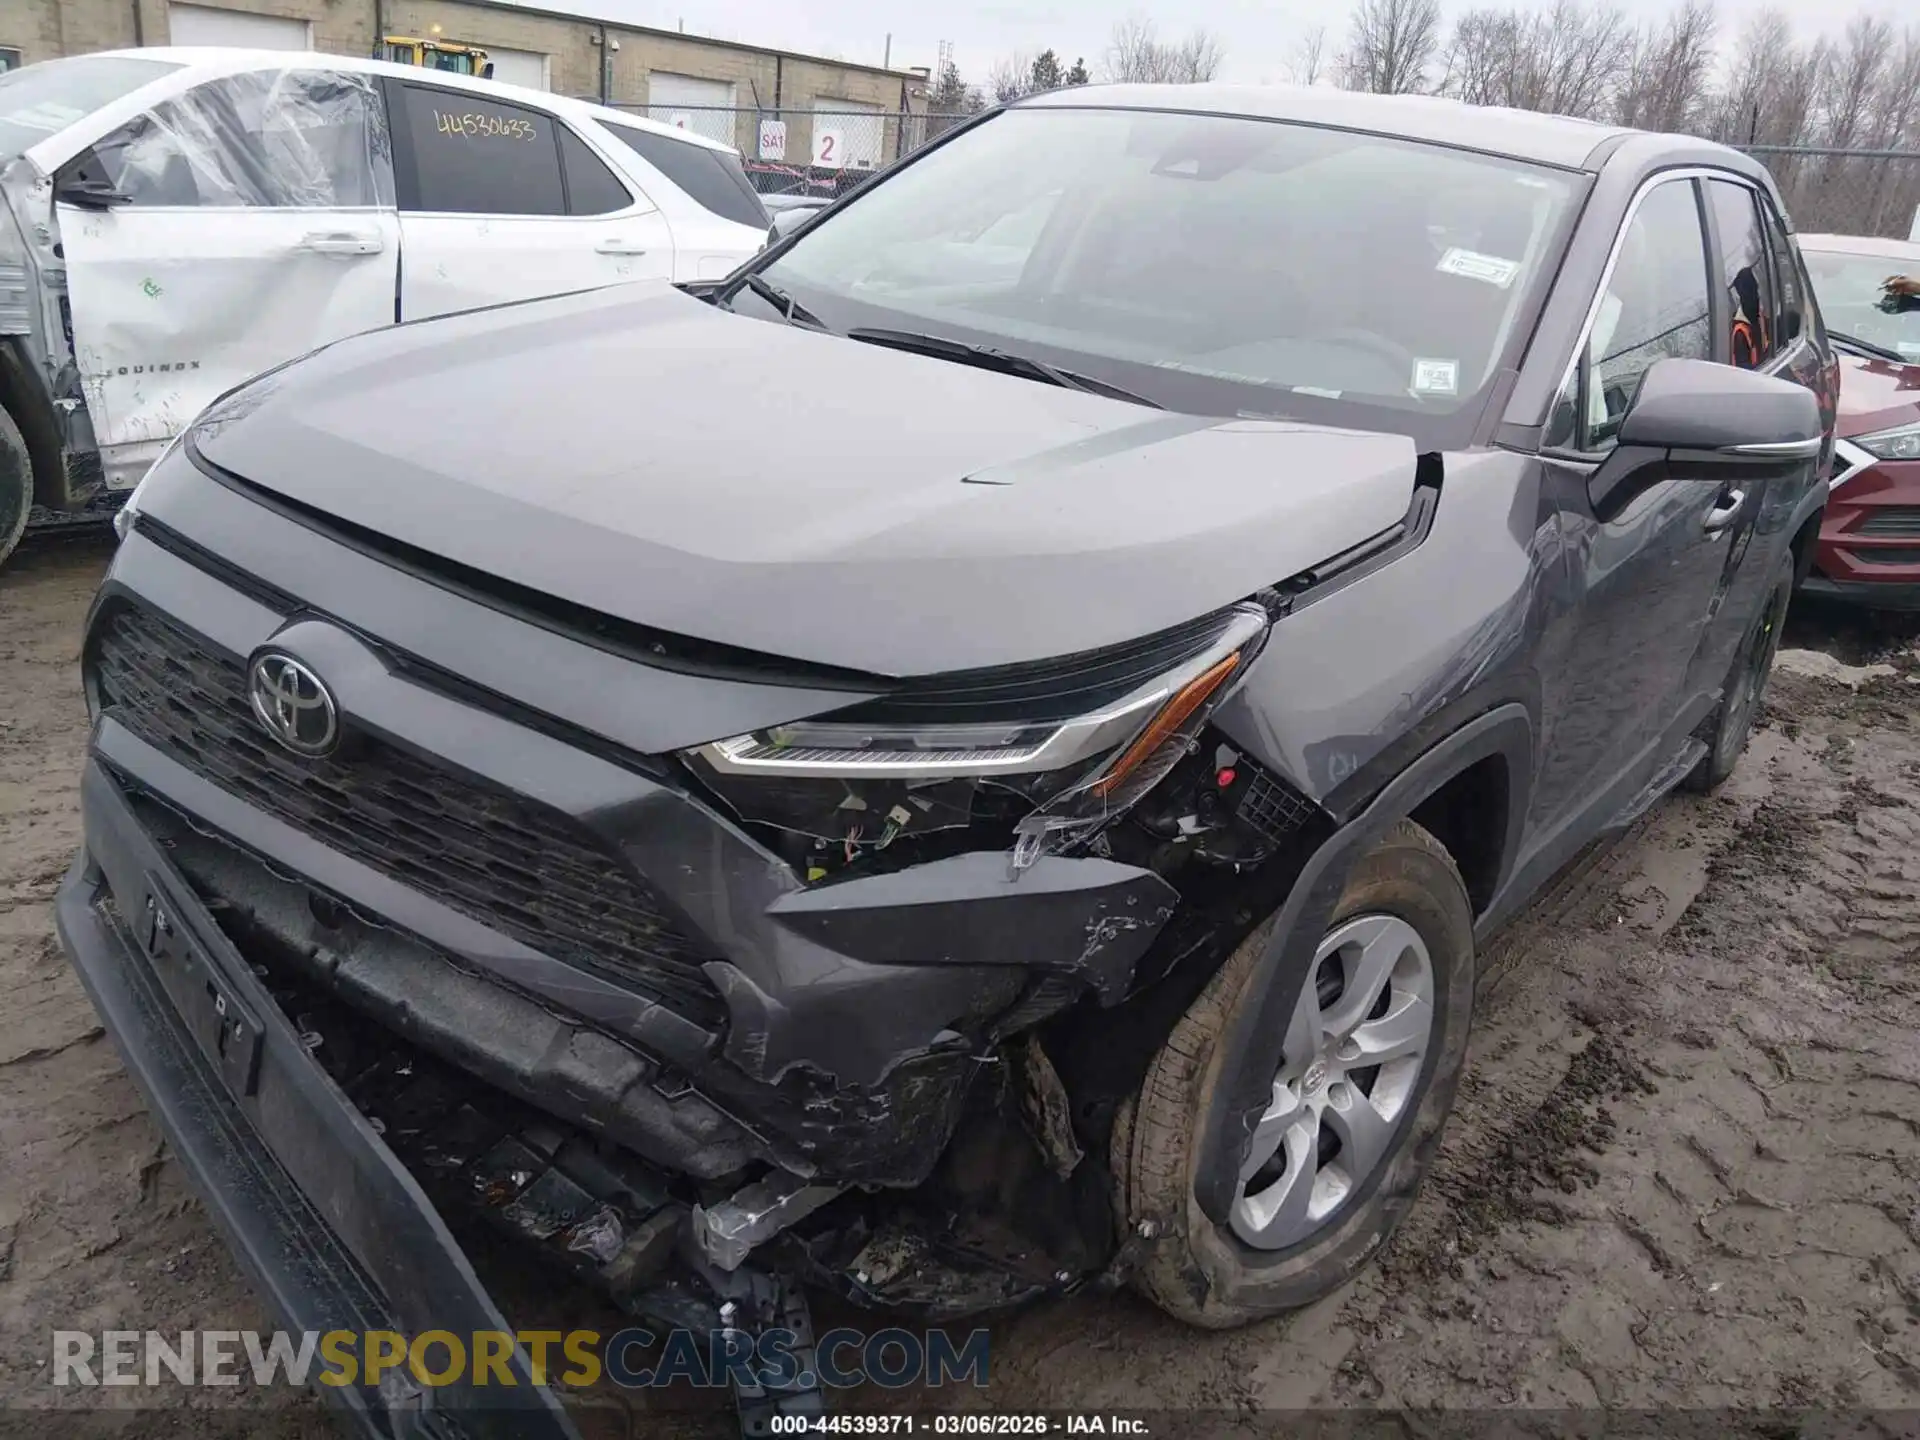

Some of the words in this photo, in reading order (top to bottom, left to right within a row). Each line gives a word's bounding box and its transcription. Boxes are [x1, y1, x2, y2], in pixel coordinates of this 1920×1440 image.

[433, 109, 537, 141] 44530633
[761, 134, 785, 149] SA1
[820, 135, 834, 161] 2
